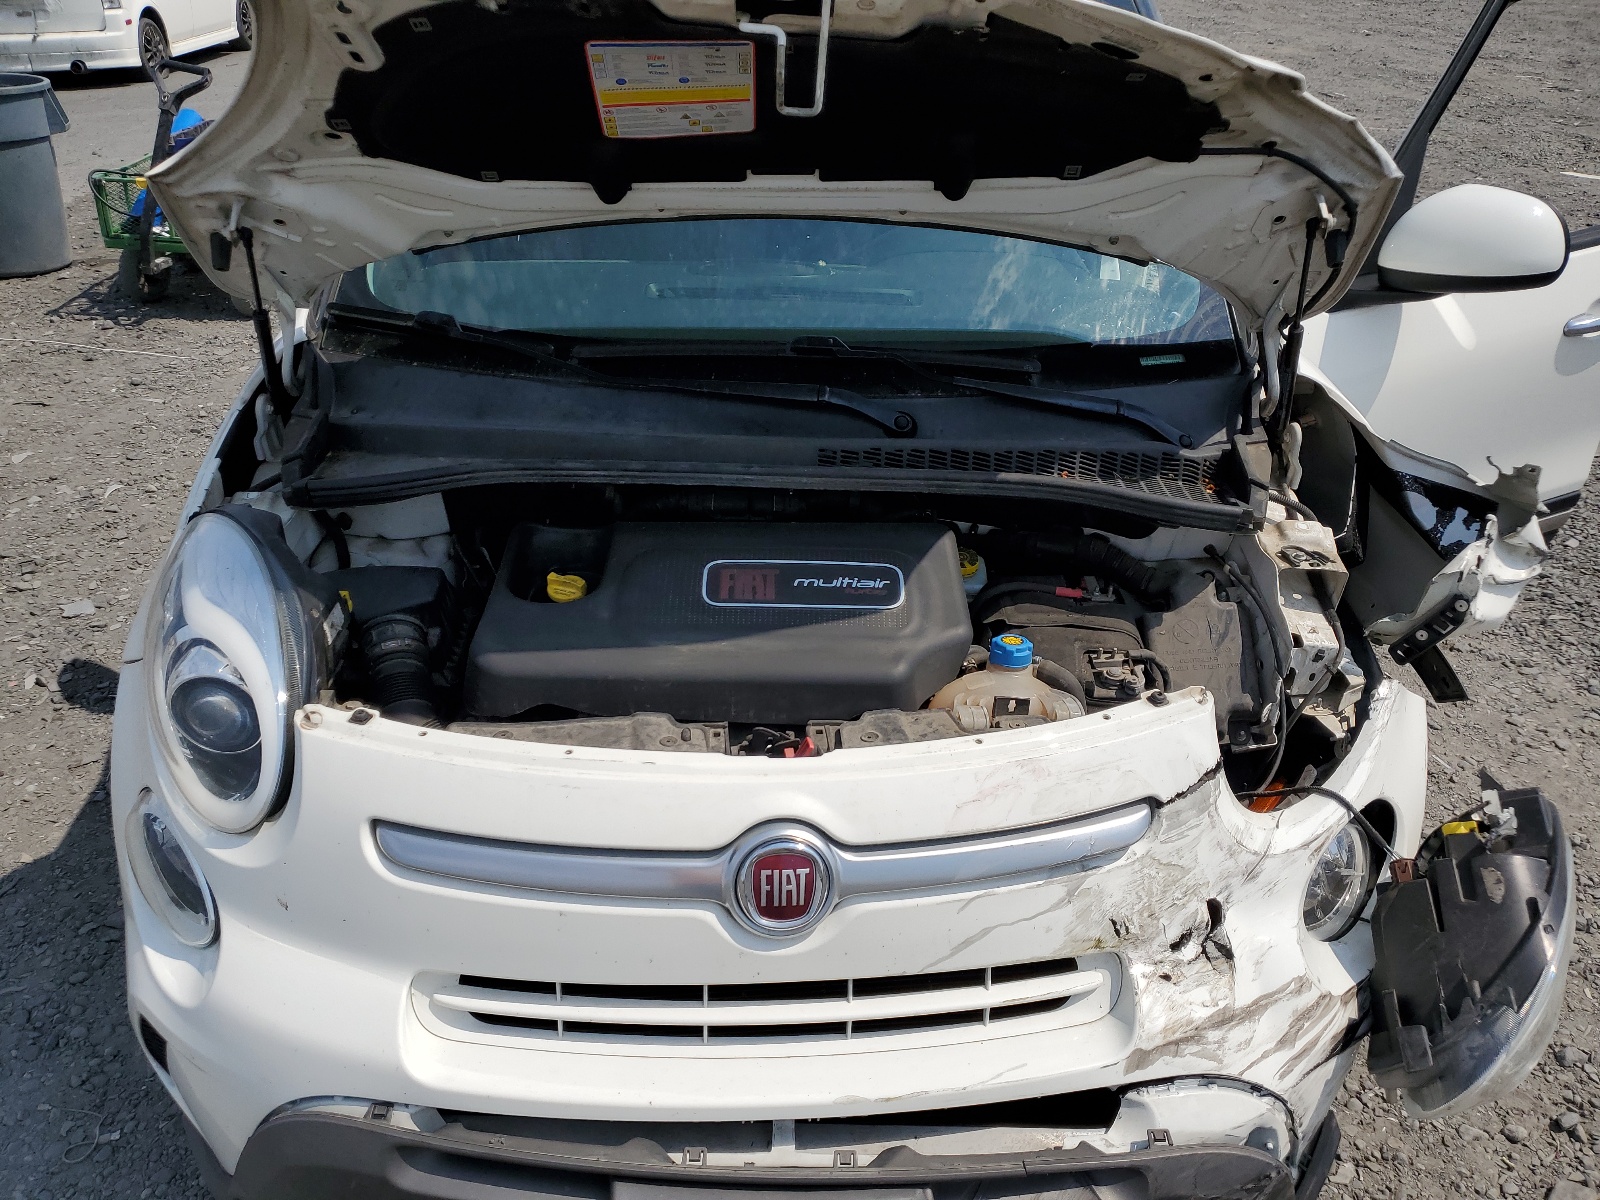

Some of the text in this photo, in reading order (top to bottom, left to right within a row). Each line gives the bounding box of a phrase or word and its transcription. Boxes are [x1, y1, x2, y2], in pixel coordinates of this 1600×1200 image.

[719, 569, 891, 600] FIAT multiair
[761, 868, 810, 907] FIAT
